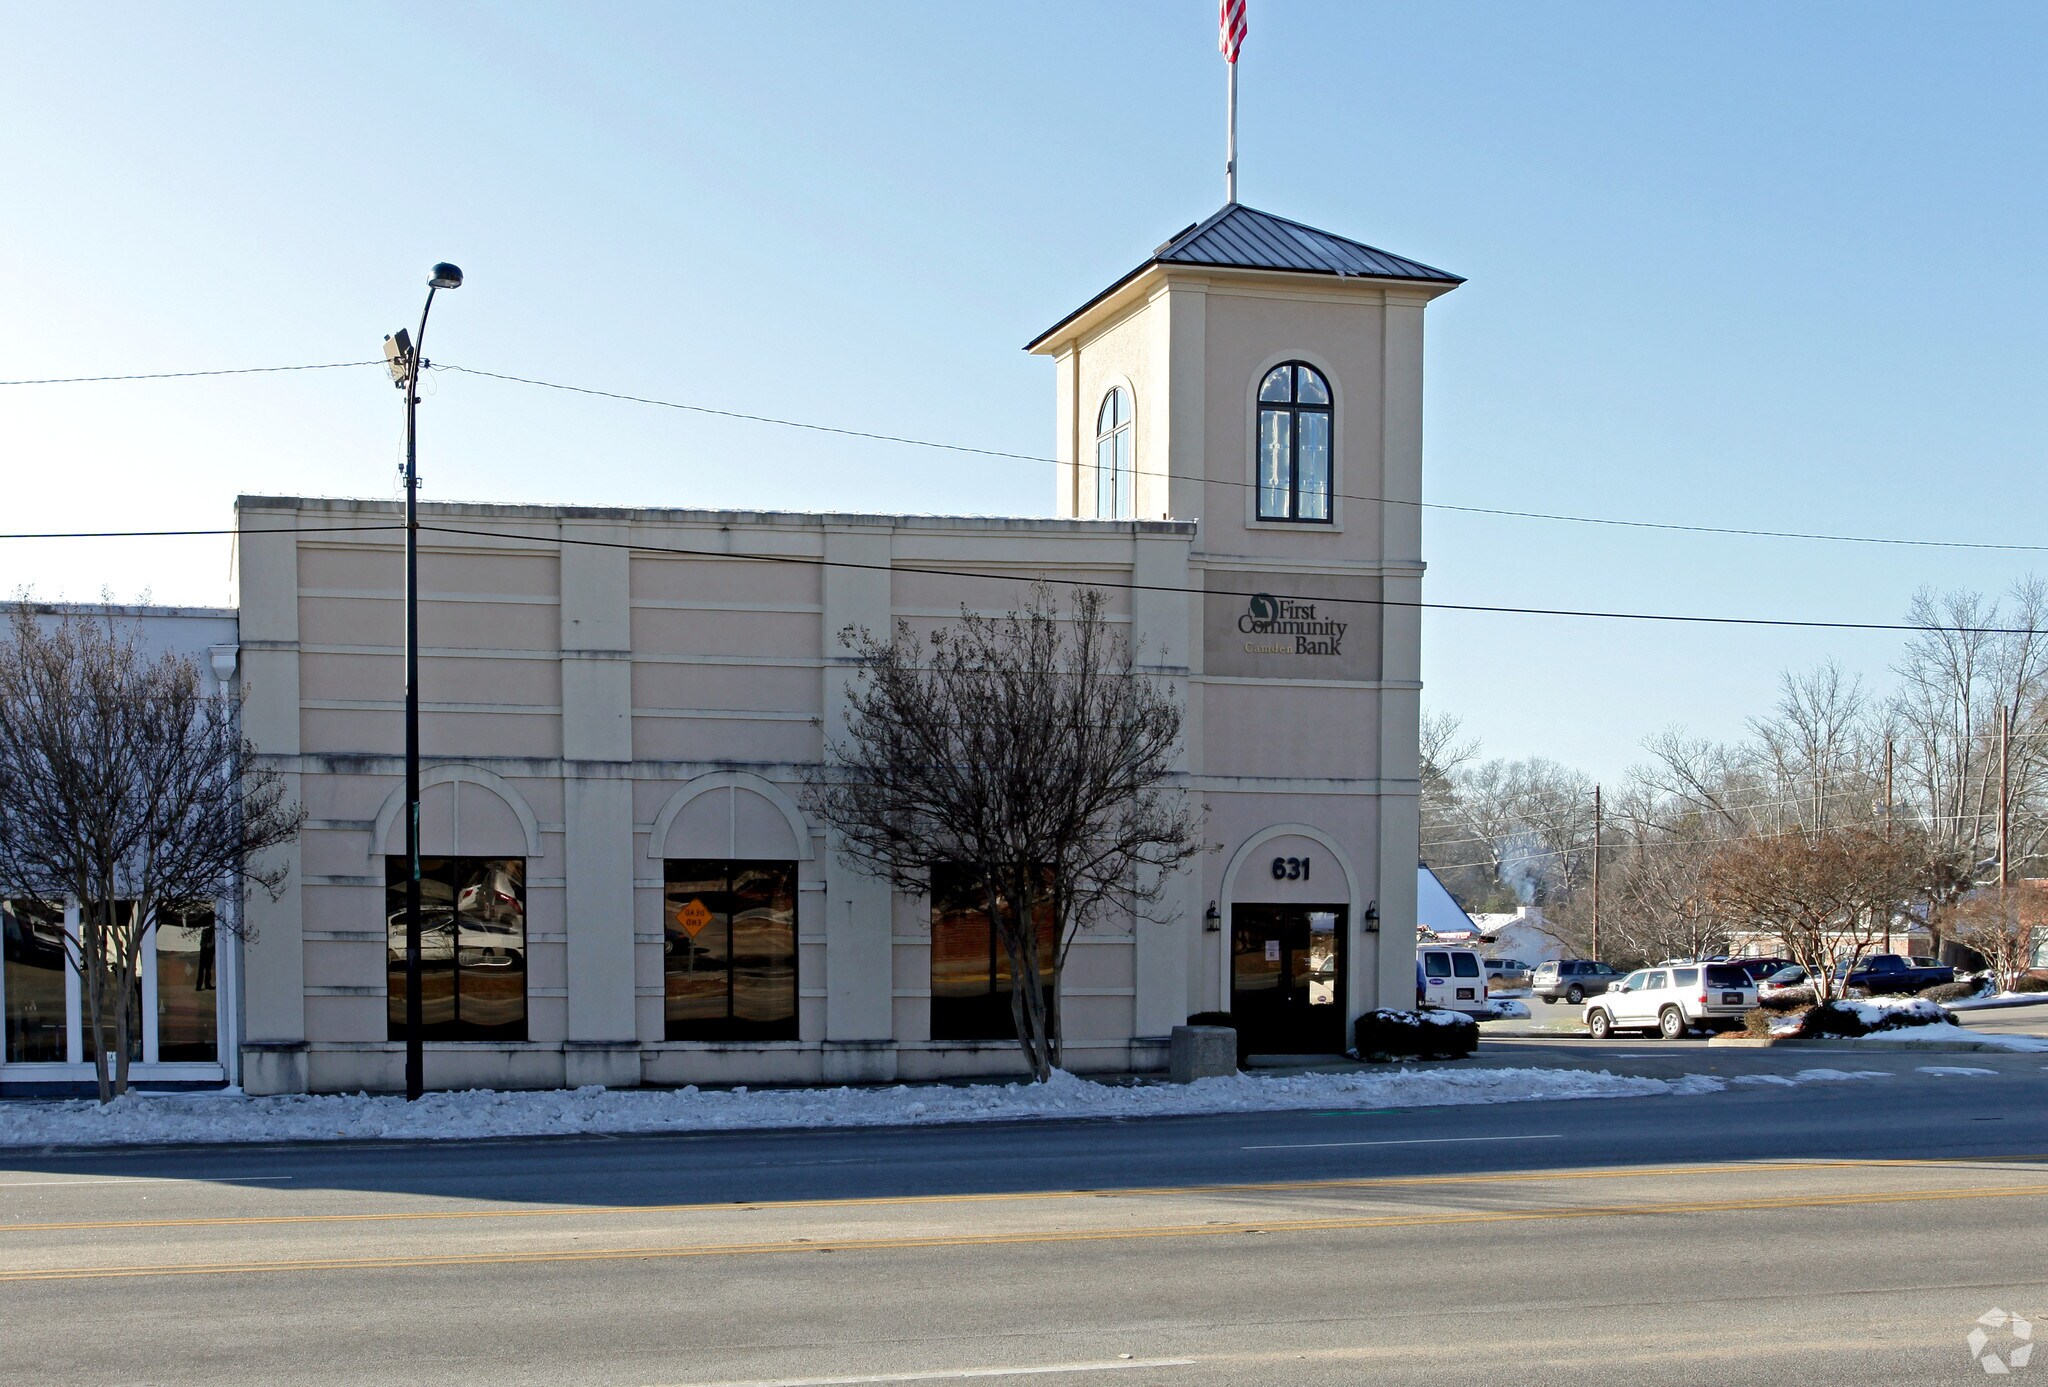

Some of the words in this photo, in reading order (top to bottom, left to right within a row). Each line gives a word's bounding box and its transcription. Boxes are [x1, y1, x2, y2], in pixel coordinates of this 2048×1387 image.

[1279, 600, 1317, 620] First
[1238, 613, 1347, 641] Community
[1244, 641, 1294, 654] Camden
[1295, 635, 1342, 656] Bank
[1272, 857, 1311, 881] 631
